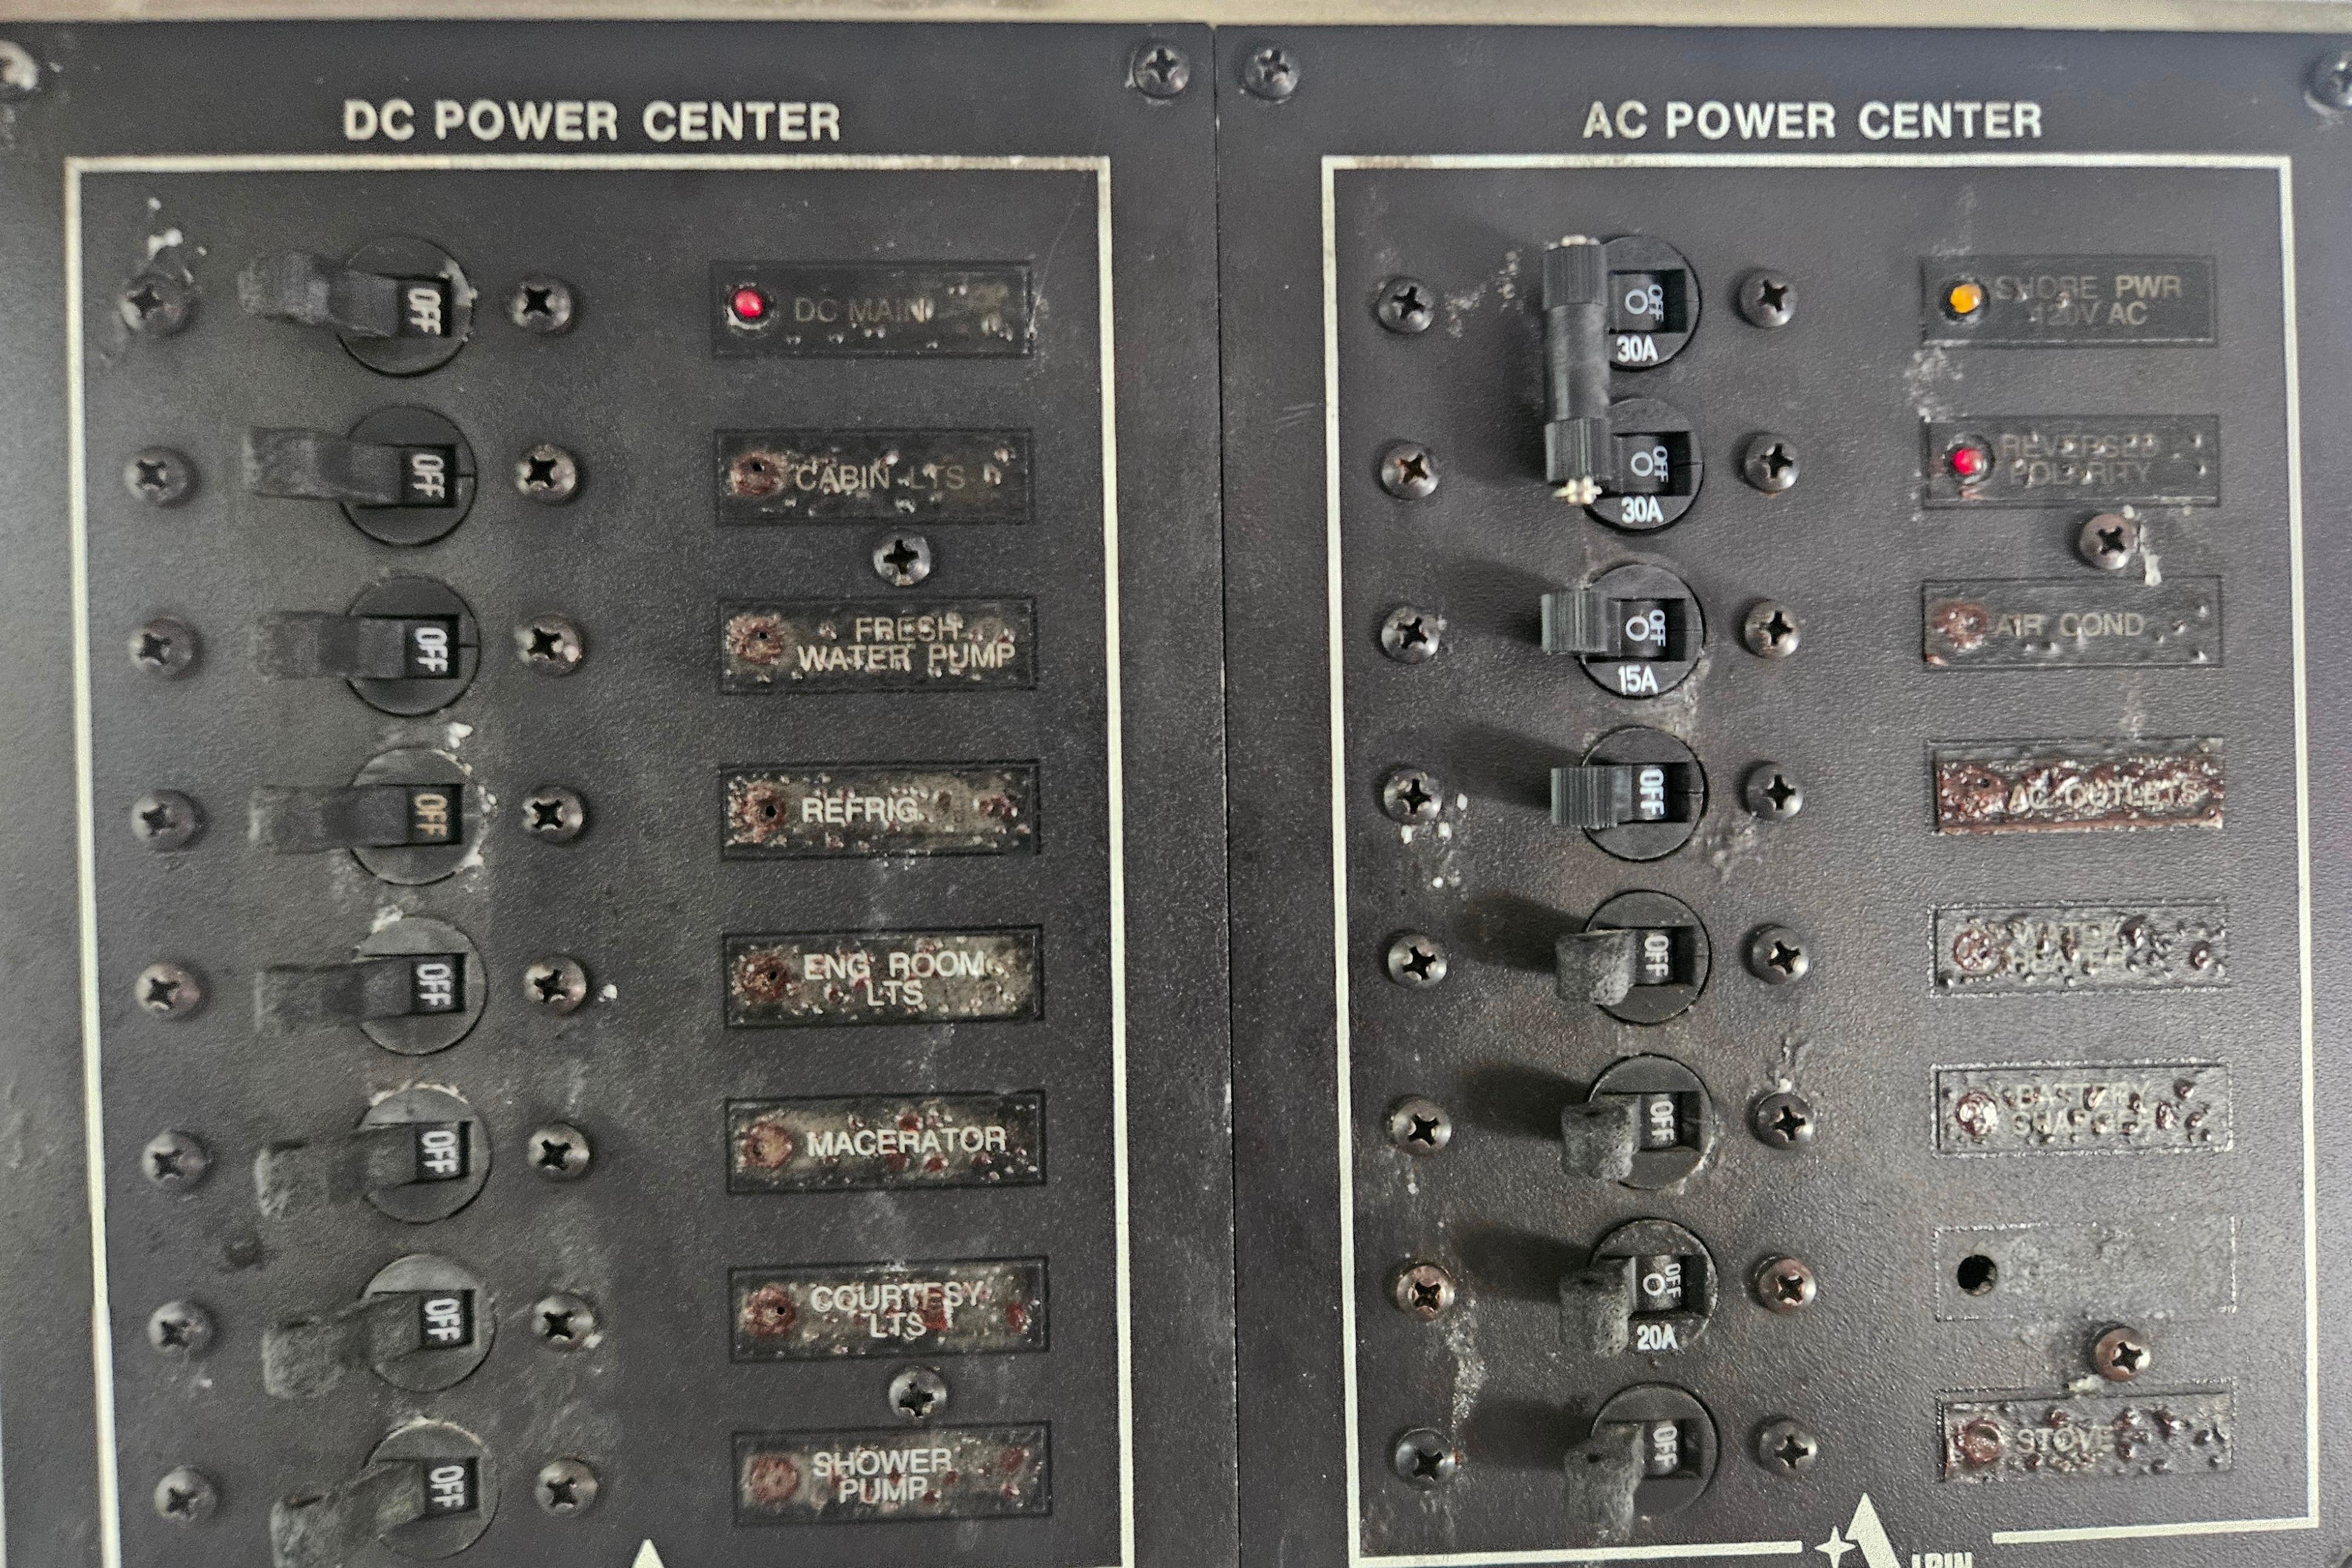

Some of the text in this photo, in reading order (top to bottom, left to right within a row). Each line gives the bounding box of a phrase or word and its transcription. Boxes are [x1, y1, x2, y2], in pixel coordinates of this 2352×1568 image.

[345, 99, 841, 143] DC POWER CENTER
[1582, 99, 2042, 141] AC POWER CENTER
[1996, 274, 2183, 300] SHORE PWR
[407, 287, 442, 336] OFF
[796, 296, 837, 322] DC
[2108, 300, 2148, 326] AC
[1617, 335, 1658, 362] 30A
[412, 453, 446, 499] OFF
[796, 465, 966, 491] CABIN LTS
[1621, 496, 1664, 523] 30A
[856, 616, 958, 642] FRESH
[1996, 612, 2145, 637] AIR COND
[415, 627, 449, 673] OFF
[798, 644, 1015, 671] WATER PUMP
[1618, 664, 1658, 694] 15A
[1639, 768, 1665, 815] OFF
[415, 793, 448, 838] OFF
[803, 950, 985, 979] ENG ROOM
[1645, 935, 1670, 977] OFF
[416, 963, 452, 1007] OFF
[867, 980, 924, 1006] LTS
[1650, 1100, 1675, 1142] OFF
[421, 1130, 457, 1175] OFF
[807, 1125, 1007, 1157] MACERATOR
[1664, 1262, 1682, 1298] OFF
[811, 1281, 985, 1312] COURTESY
[425, 1298, 461, 1341] OFF
[870, 1312, 927, 1338] LTS
[1637, 1323, 1678, 1350] 20A
[1653, 1425, 1678, 1467] OFF
[2016, 1426, 2114, 1455] STOVE
[813, 1447, 951, 1477] SHOWER
[430, 1465, 465, 1508] OFF
[839, 1475, 928, 1503] PUMP
